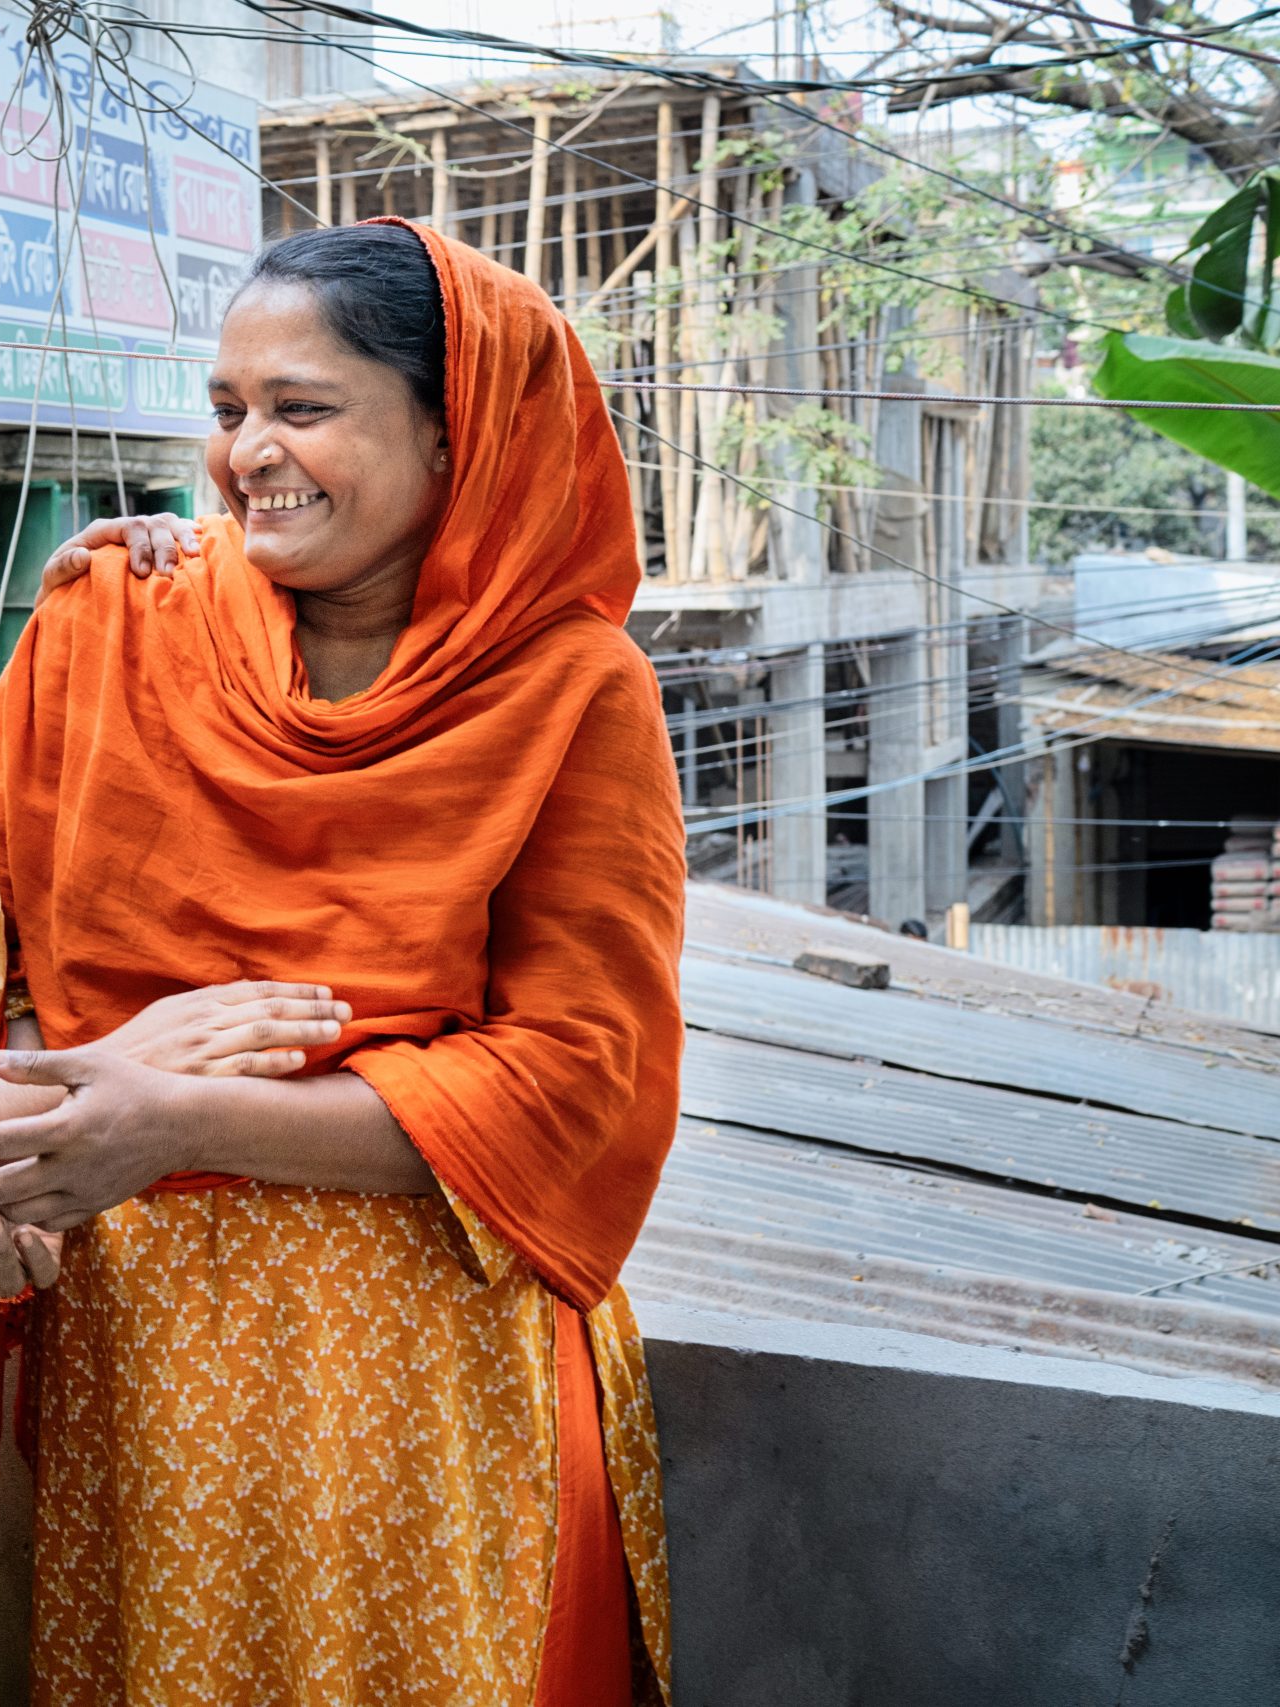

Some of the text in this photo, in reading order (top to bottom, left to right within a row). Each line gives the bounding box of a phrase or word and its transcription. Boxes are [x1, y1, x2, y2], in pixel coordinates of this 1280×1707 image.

[8, 40, 127, 123] সইন
[176, 166, 240, 239] ব্যানার
[24, 222, 55, 297] বোর্ড
